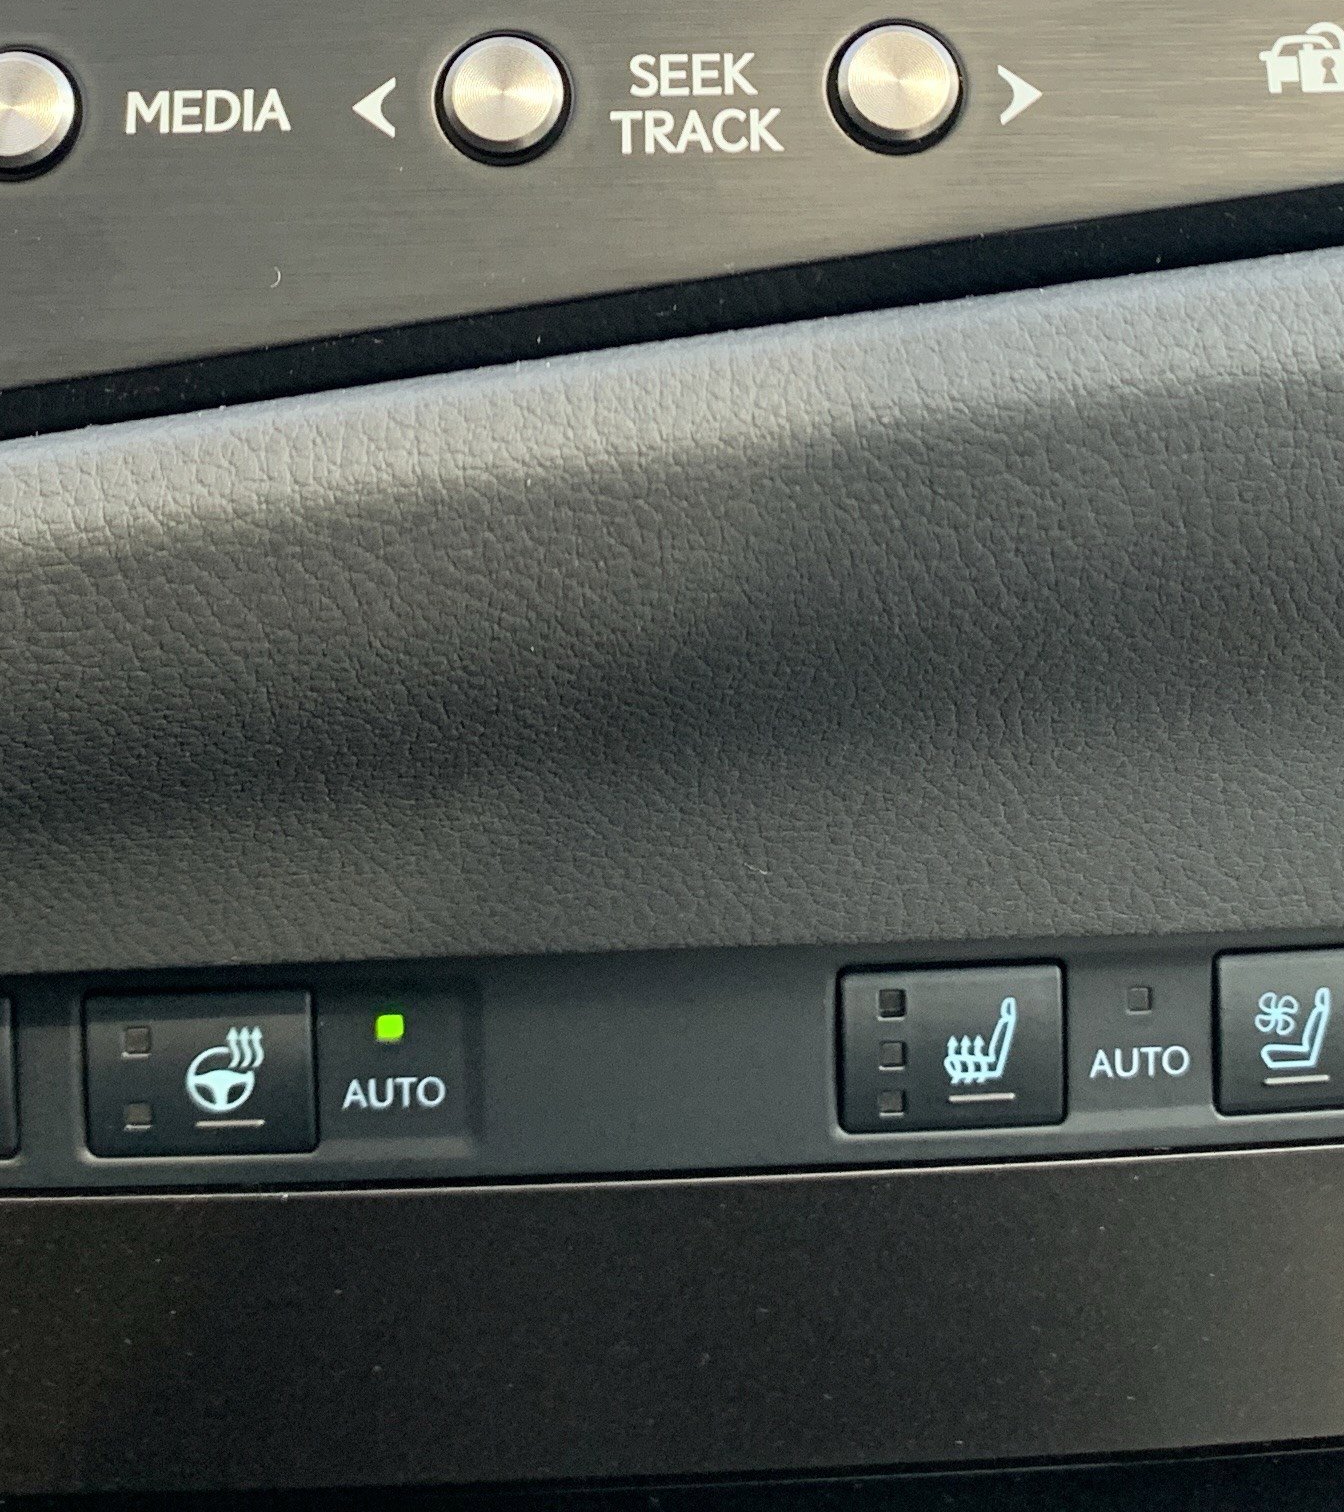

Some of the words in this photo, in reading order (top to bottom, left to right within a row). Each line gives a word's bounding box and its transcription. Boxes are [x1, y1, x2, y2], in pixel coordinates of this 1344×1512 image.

[628, 52, 759, 96] SEEK
[124, 87, 292, 135] MEDIA
[610, 108, 784, 155] TRACK
[1090, 1045, 1190, 1080] AUTO
[343, 1074, 445, 1110] AUTO
